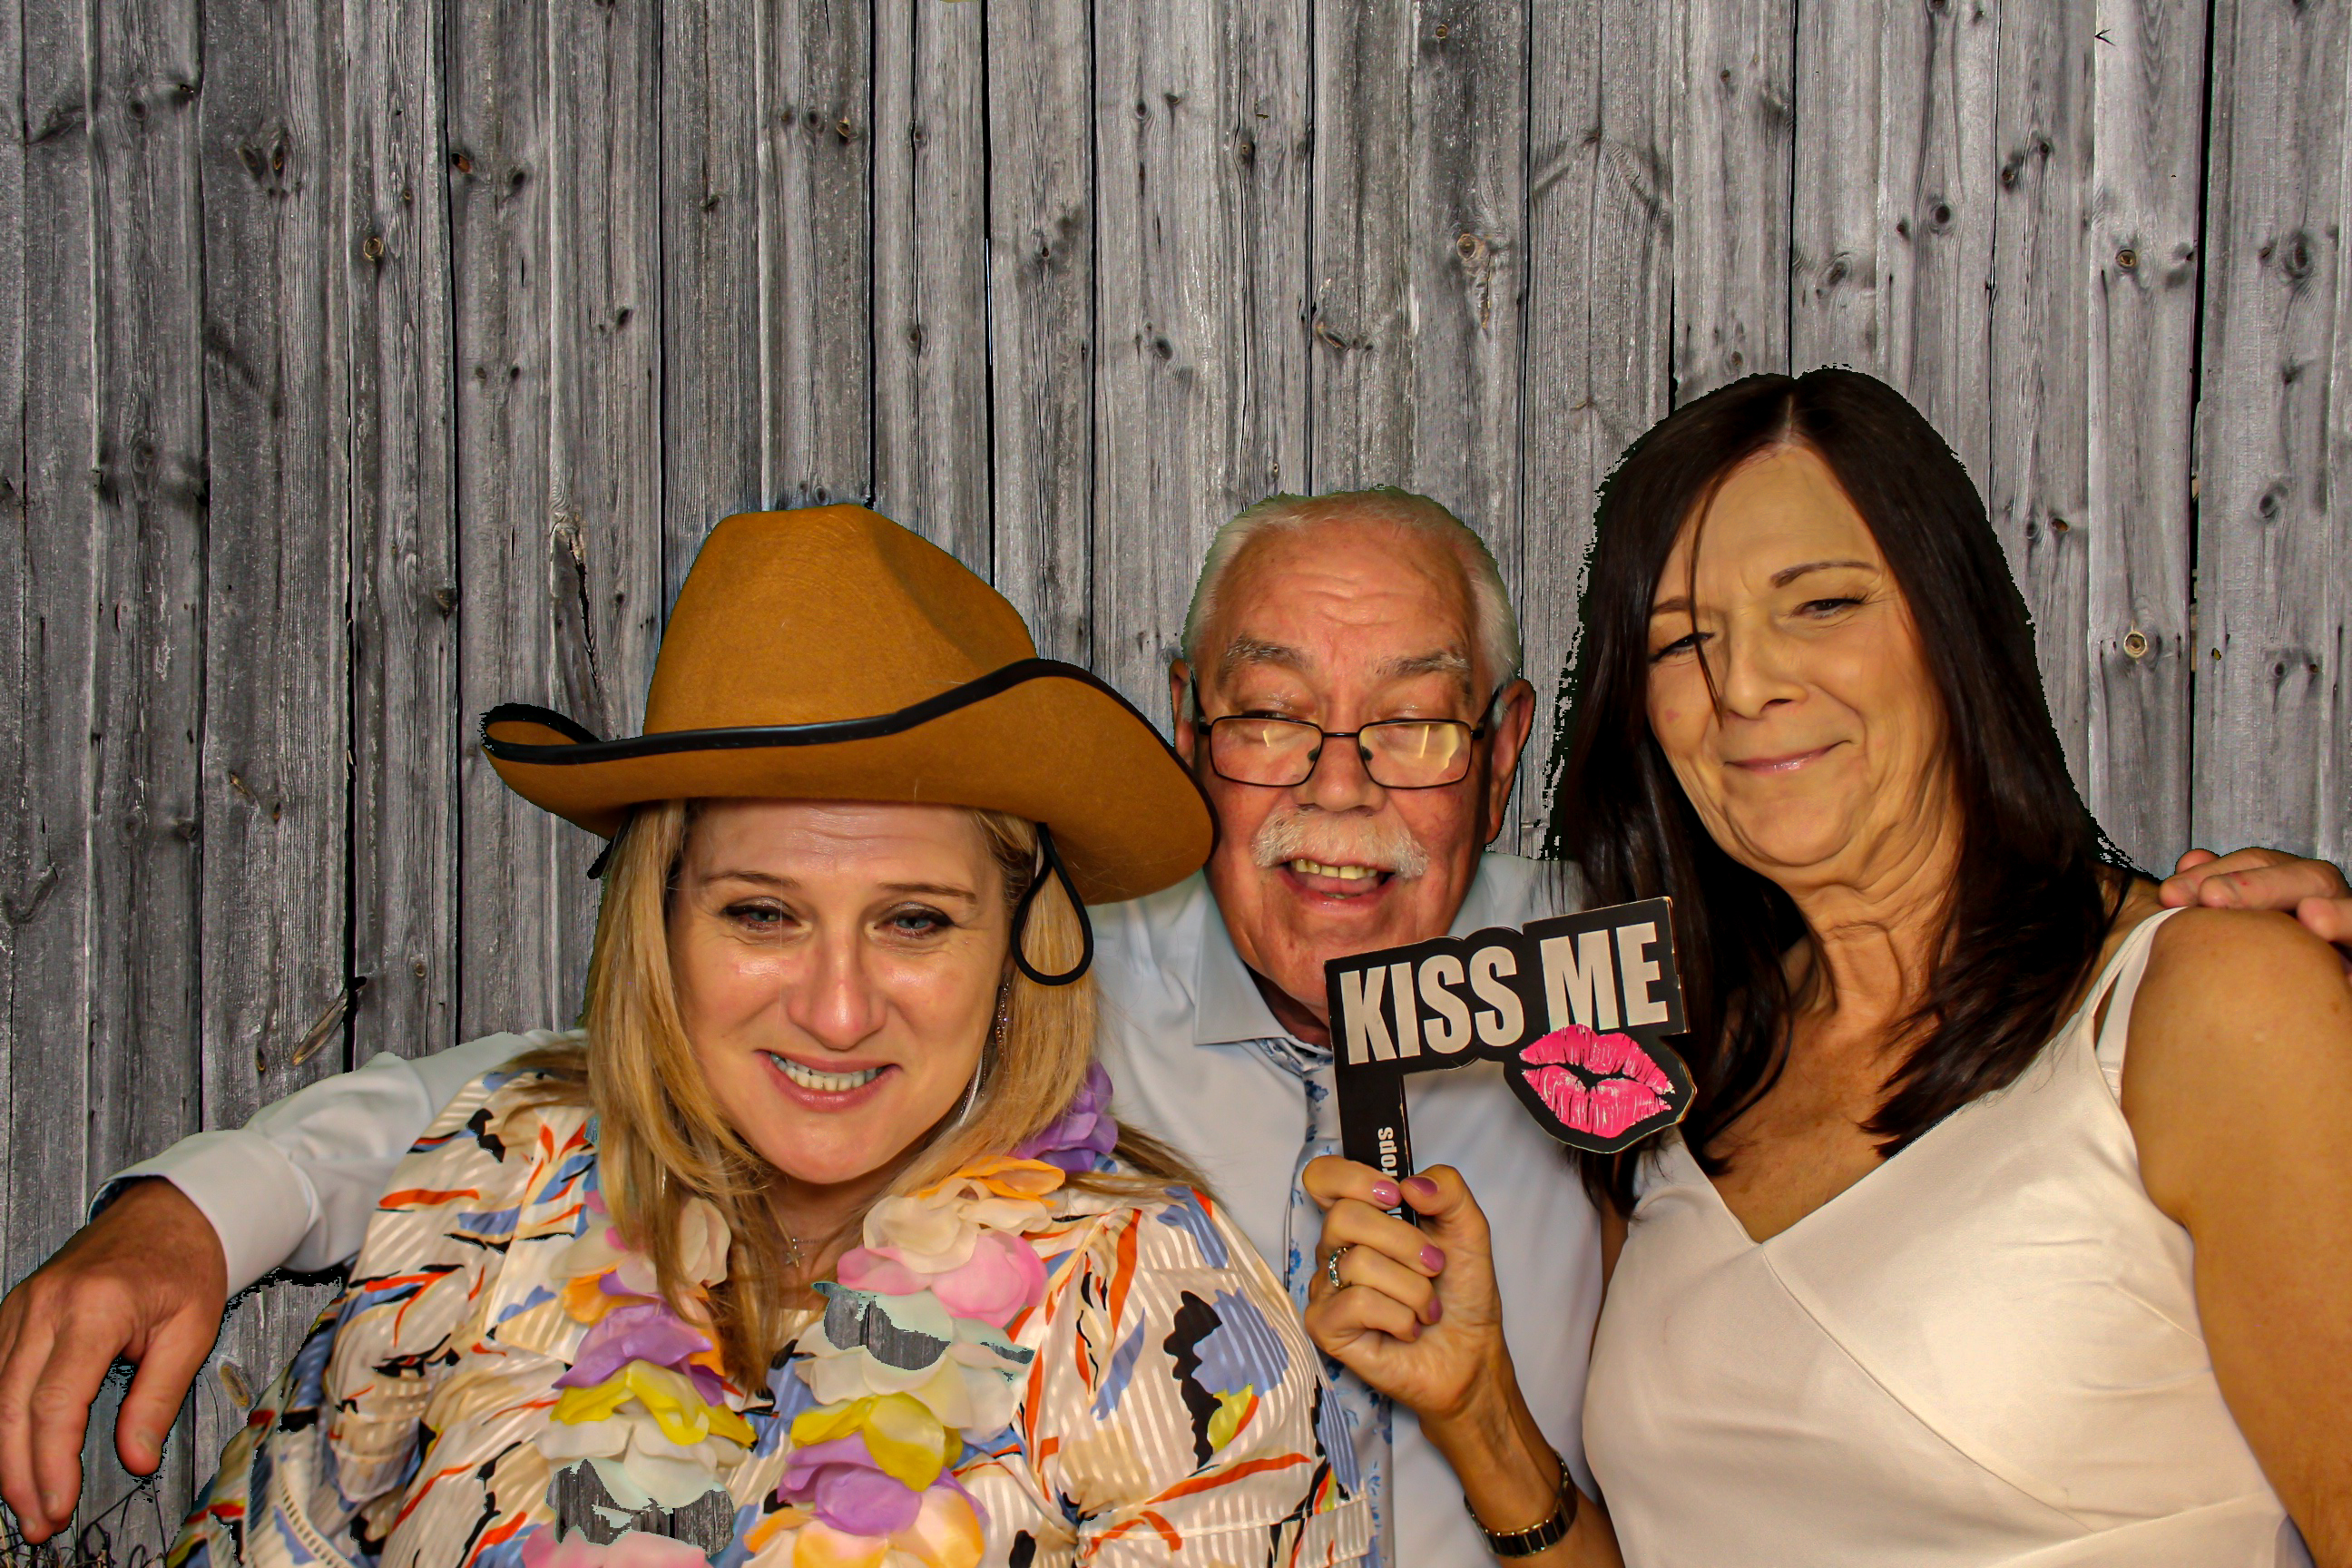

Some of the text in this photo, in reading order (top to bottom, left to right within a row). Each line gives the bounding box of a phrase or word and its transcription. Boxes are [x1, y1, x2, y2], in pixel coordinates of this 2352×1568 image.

[1339, 921, 1669, 1065] KISS ME
[1377, 1126, 1398, 1177] rops
